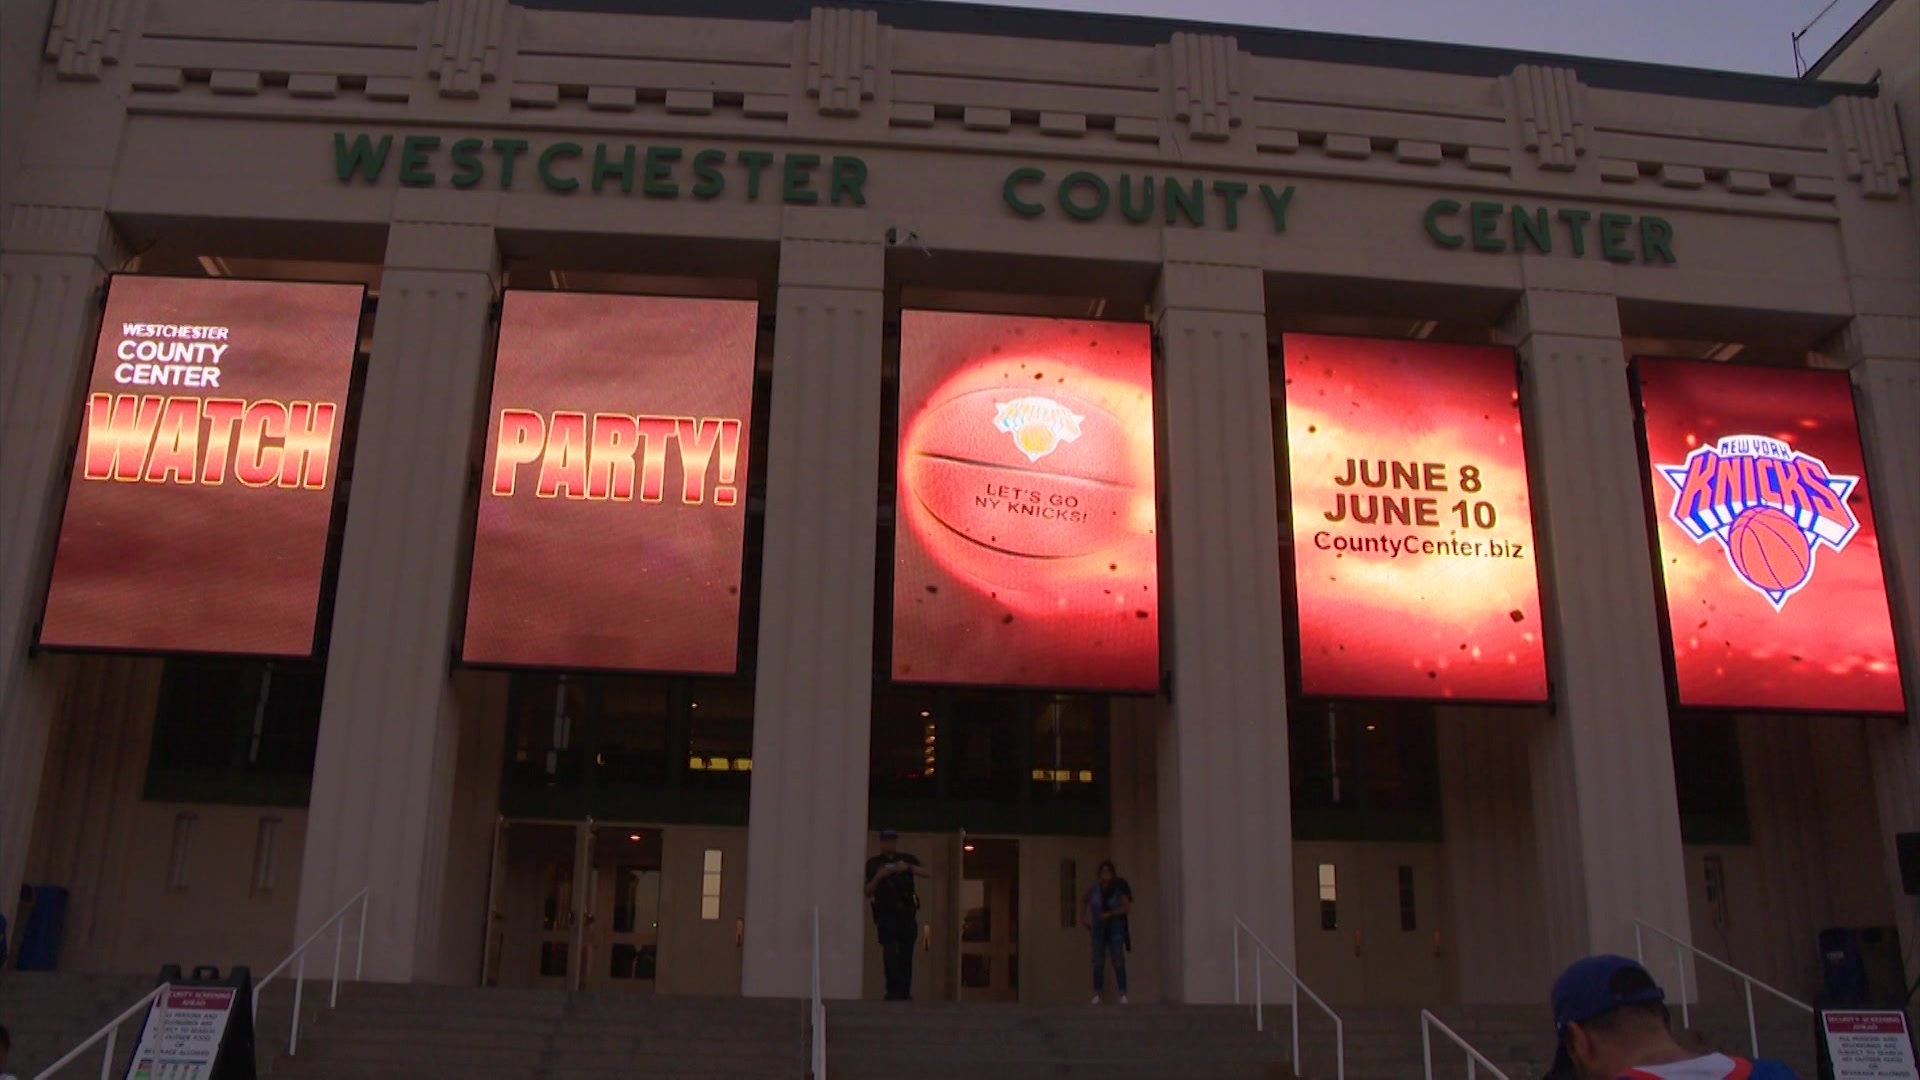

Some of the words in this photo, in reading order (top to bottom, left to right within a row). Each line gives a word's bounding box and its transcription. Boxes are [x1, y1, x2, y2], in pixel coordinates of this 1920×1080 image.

[333, 132, 868, 206] WESTCHESTER
[1003, 167, 1295, 233] COUNTY
[1424, 199, 1675, 264] CENTER
[122, 322, 229, 340] WESTCHESTER
[117, 340, 228, 364] COUNTY
[114, 364, 220, 388] CENTER
[84, 392, 336, 490] WATCH
[1720, 439, 1750, 456] NEW
[1752, 440, 1791, 460] YORK
[492, 408, 742, 506] PARTY!
[1334, 458, 1448, 492] JUNE
[1458, 464, 1482, 494] 8
[986, 483, 1042, 504] LET'S
[1049, 493, 1079, 509] GO
[1674, 450, 1855, 533] KNICKS
[975, 495, 1001, 510] NY
[1007, 501, 1088, 524] KNICKS!
[1323, 493, 1440, 528] JUNE
[1451, 499, 1497, 530] 10
[1313, 530, 1525, 560] CountyCenter.biz
